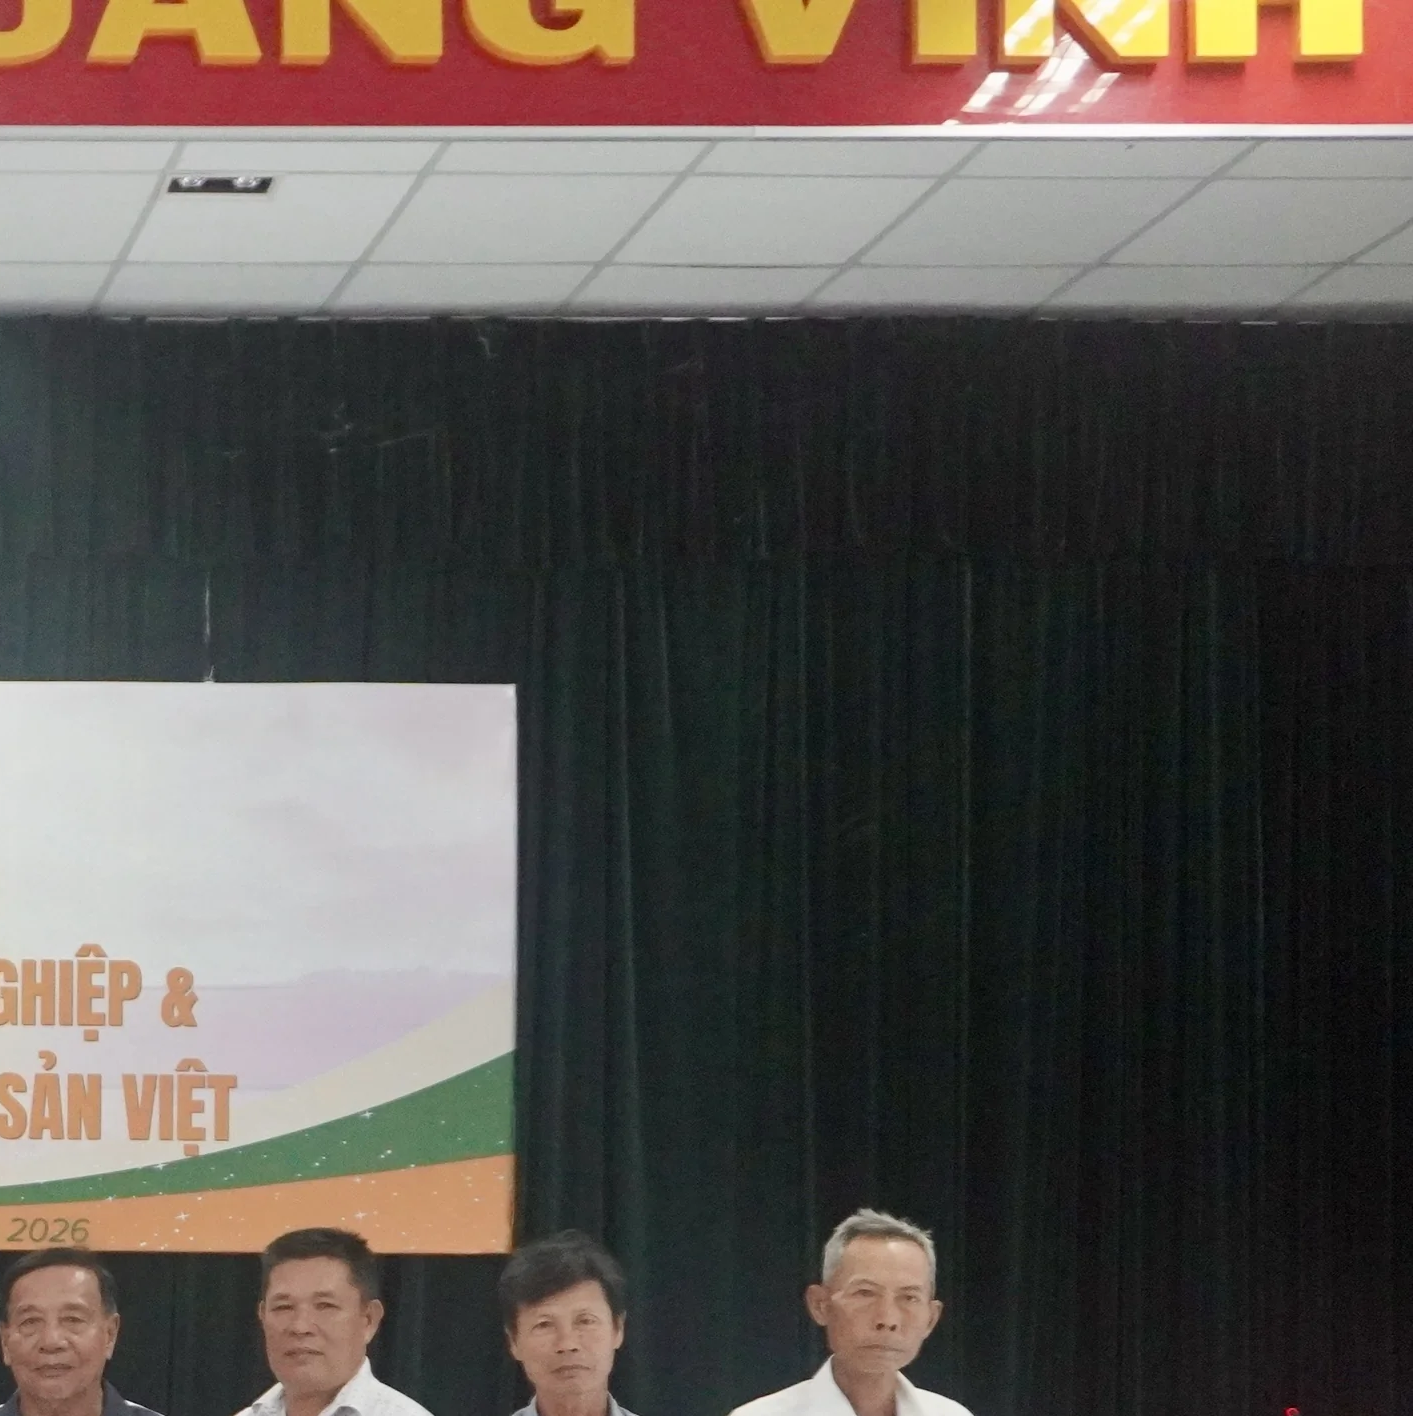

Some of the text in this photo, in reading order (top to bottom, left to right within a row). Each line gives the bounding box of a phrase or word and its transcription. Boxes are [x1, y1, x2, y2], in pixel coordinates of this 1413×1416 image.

[160, 967, 199, 1028] &
[122, 1057, 238, 1157] VIỆT
[6, 1217, 91, 1244] 2026
